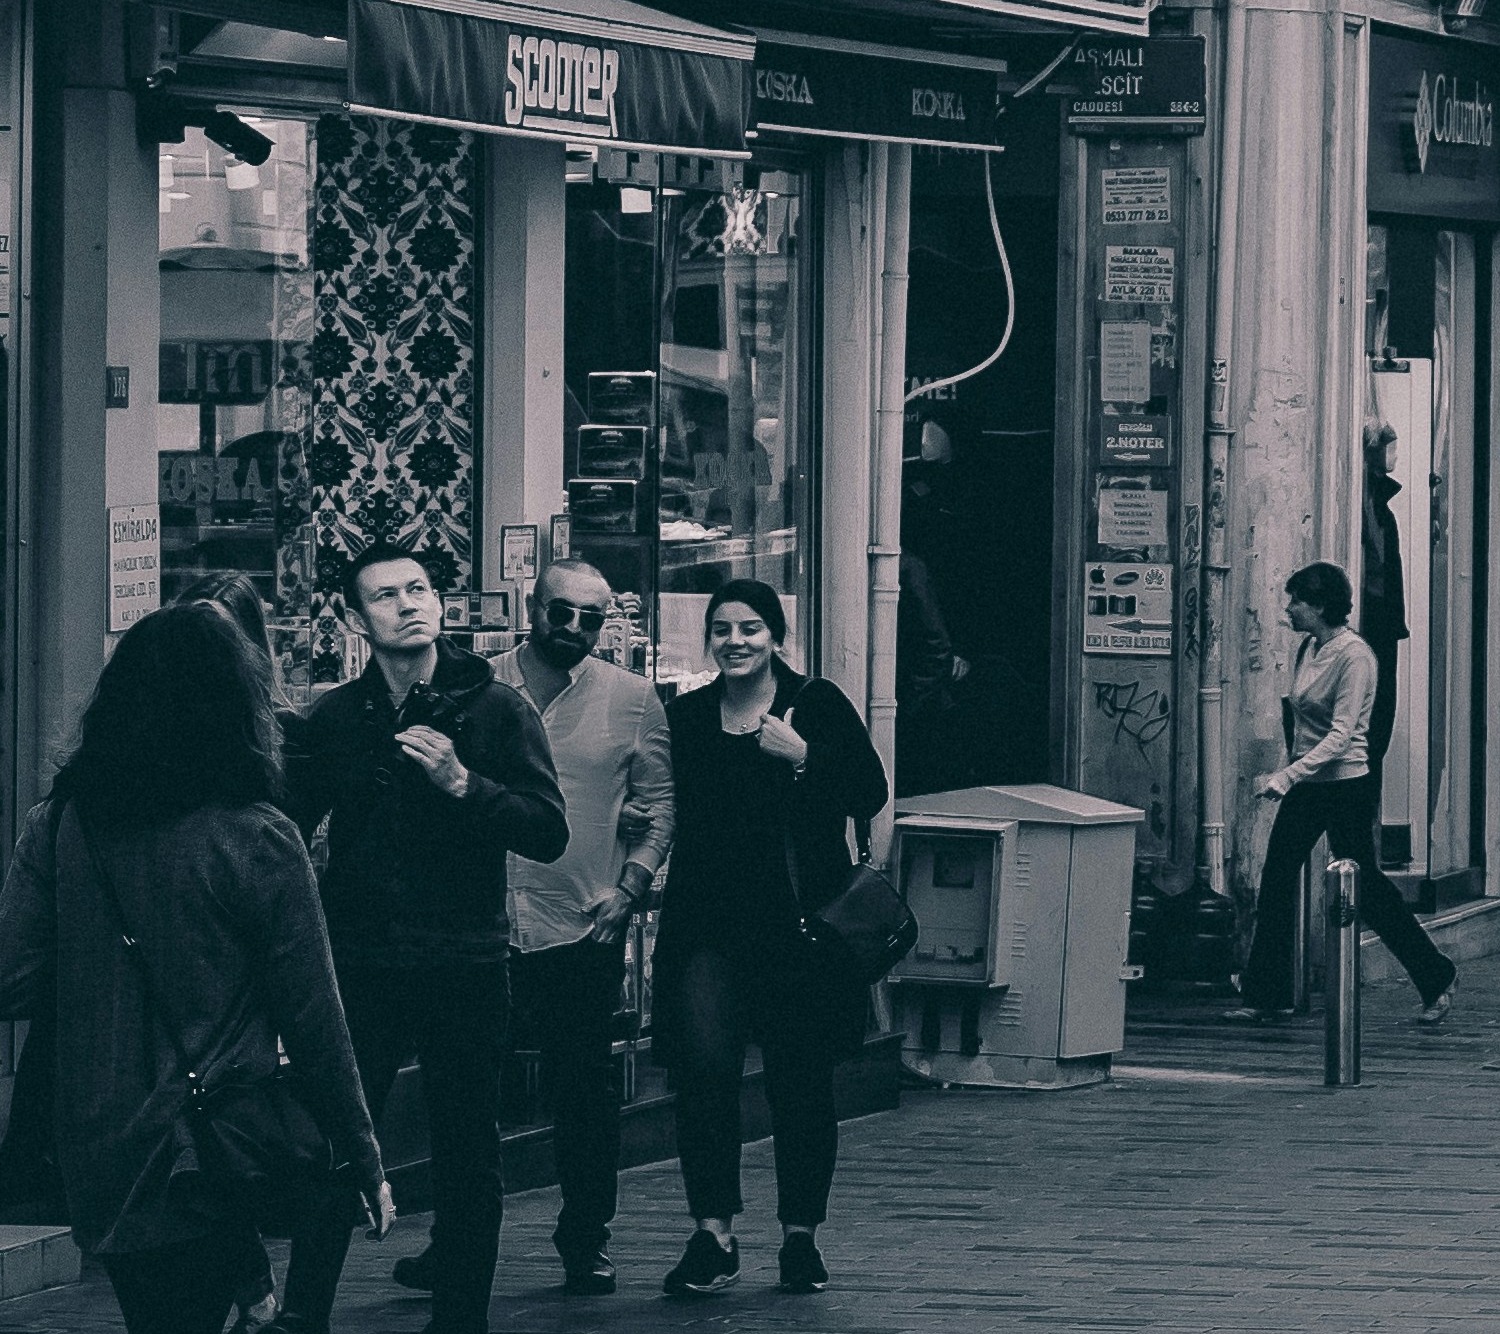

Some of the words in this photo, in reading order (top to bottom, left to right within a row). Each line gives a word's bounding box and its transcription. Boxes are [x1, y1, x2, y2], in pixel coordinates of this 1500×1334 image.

[1094, 72, 1144, 95] SCİT
[1433, 72, 1493, 147] Columbia
[1106, 436, 1165, 449] 2.NOTER
